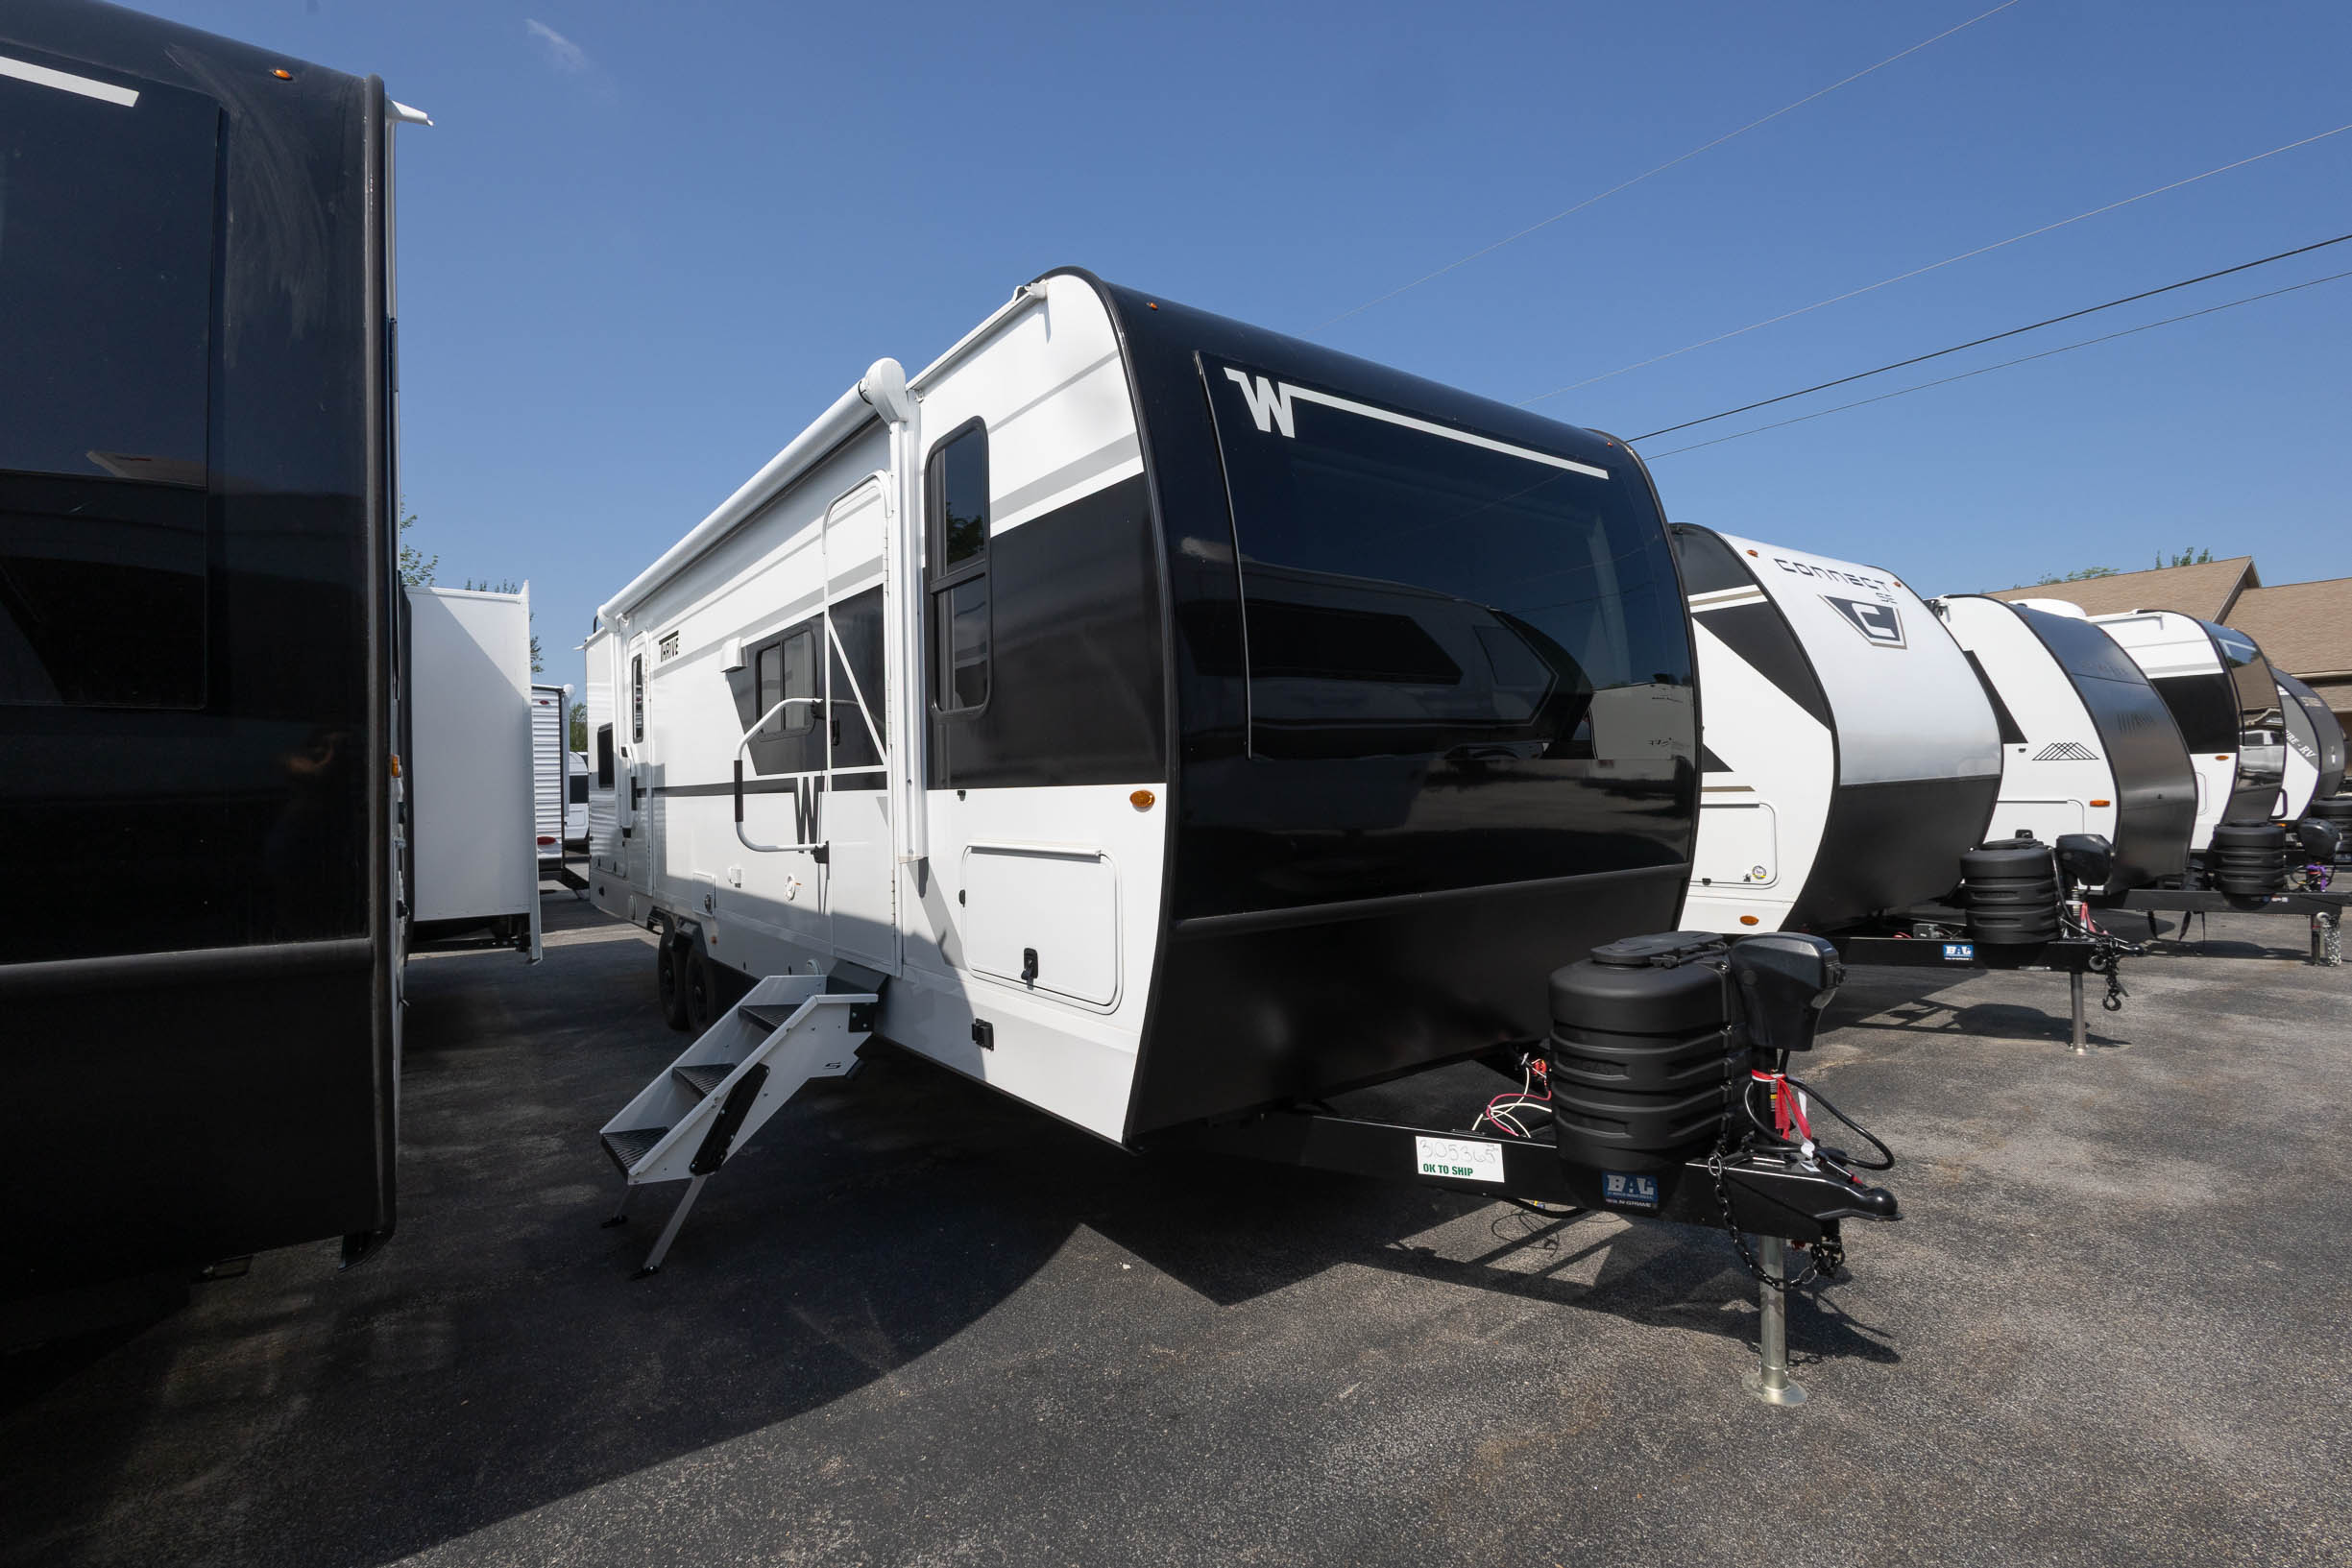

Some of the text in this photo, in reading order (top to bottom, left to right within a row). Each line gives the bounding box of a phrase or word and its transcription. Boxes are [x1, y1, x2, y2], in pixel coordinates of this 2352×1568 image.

[1223, 367, 1295, 438] W
[659, 630, 680, 663] THRIVE
[1422, 1163, 1474, 1176] OK TO SHIP
